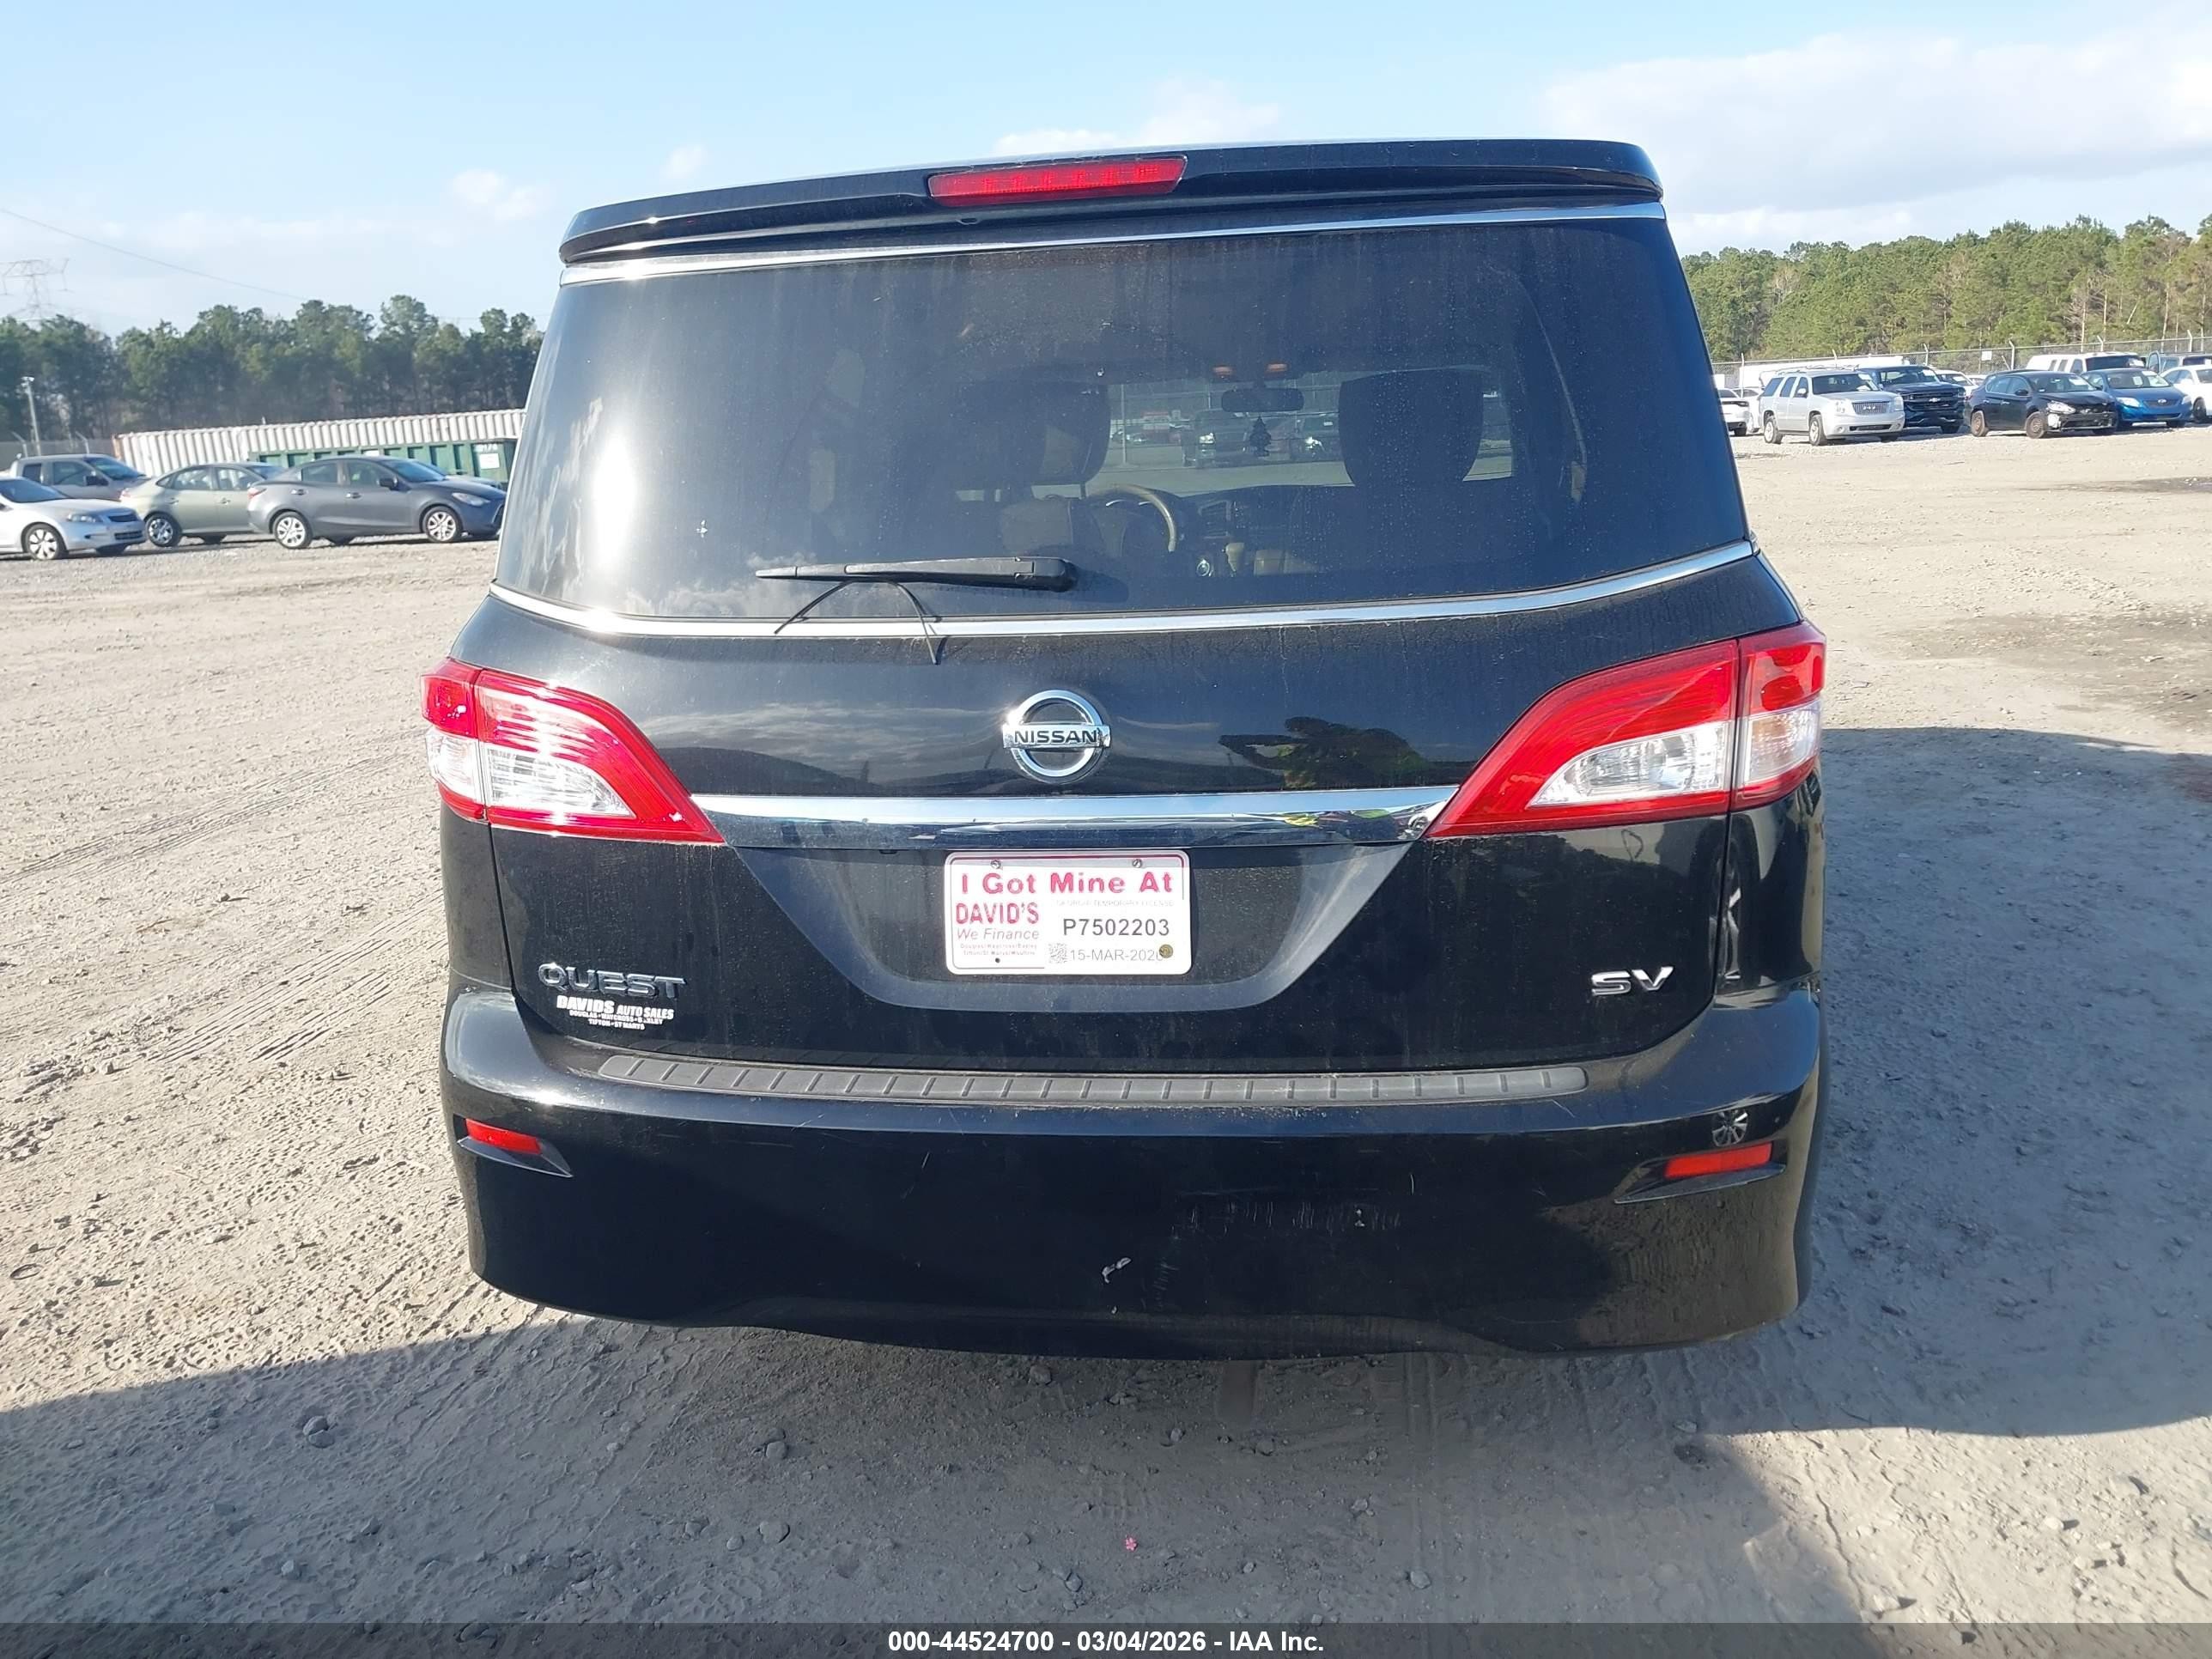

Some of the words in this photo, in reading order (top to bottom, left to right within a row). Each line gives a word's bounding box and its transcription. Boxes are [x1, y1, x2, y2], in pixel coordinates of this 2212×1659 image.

[1014, 730, 1097, 744] NISSAN
[961, 873, 969, 895] I
[981, 872, 1036, 895] Got
[1049, 872, 1126, 895] Mine
[1139, 871, 1173, 894] At
[955, 902, 1039, 925] DAVID'S
[957, 927, 979, 940] We
[982, 927, 1040, 940] Finance
[1062, 918, 1170, 936] P7502203
[538, 961, 687, 999] QUEST
[1590, 965, 1674, 996] SV
[556, 994, 615, 1015] DAVIDS
[617, 1004, 643, 1017] AUTO
[643, 1006, 675, 1020] SALES
